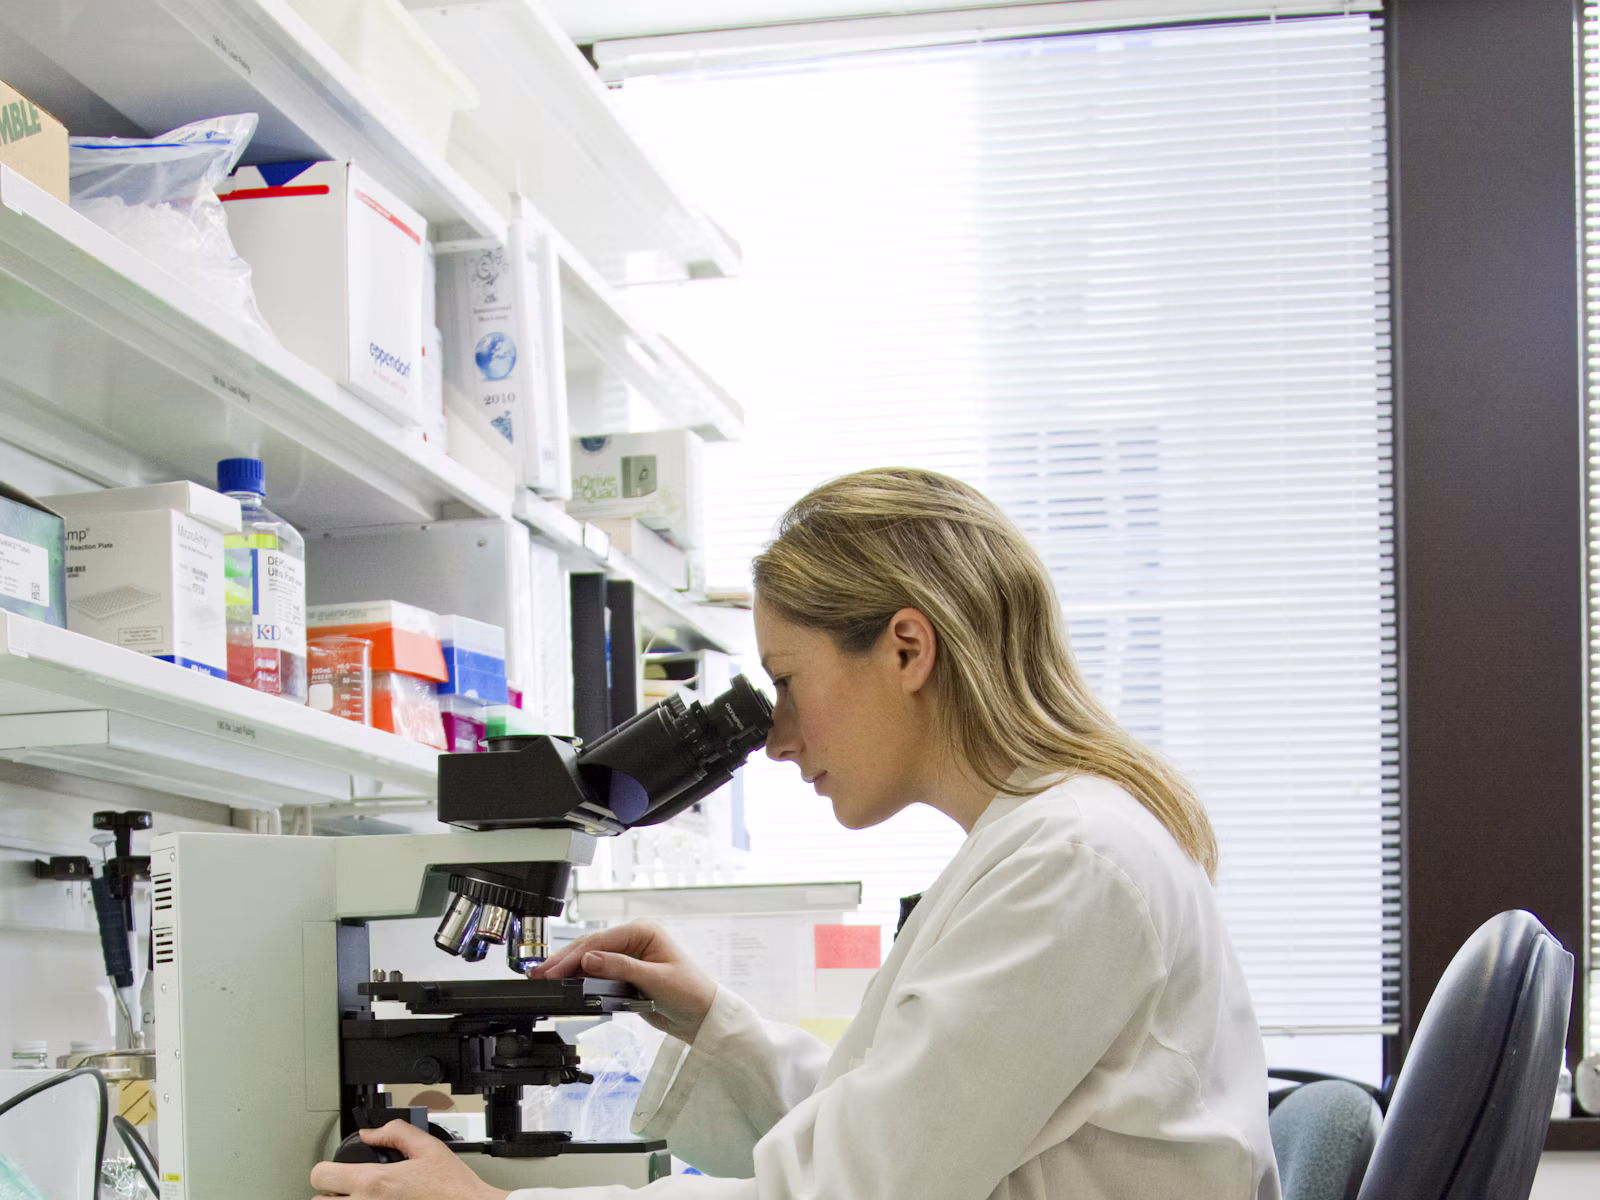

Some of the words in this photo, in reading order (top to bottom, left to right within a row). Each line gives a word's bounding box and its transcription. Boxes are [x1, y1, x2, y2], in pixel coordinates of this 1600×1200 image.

[369, 342, 411, 378] eppendorf
[483, 391, 516, 405] 2010
[724, 702, 744, 731] OLYMPUS
[69, 863, 75, 874] 3
